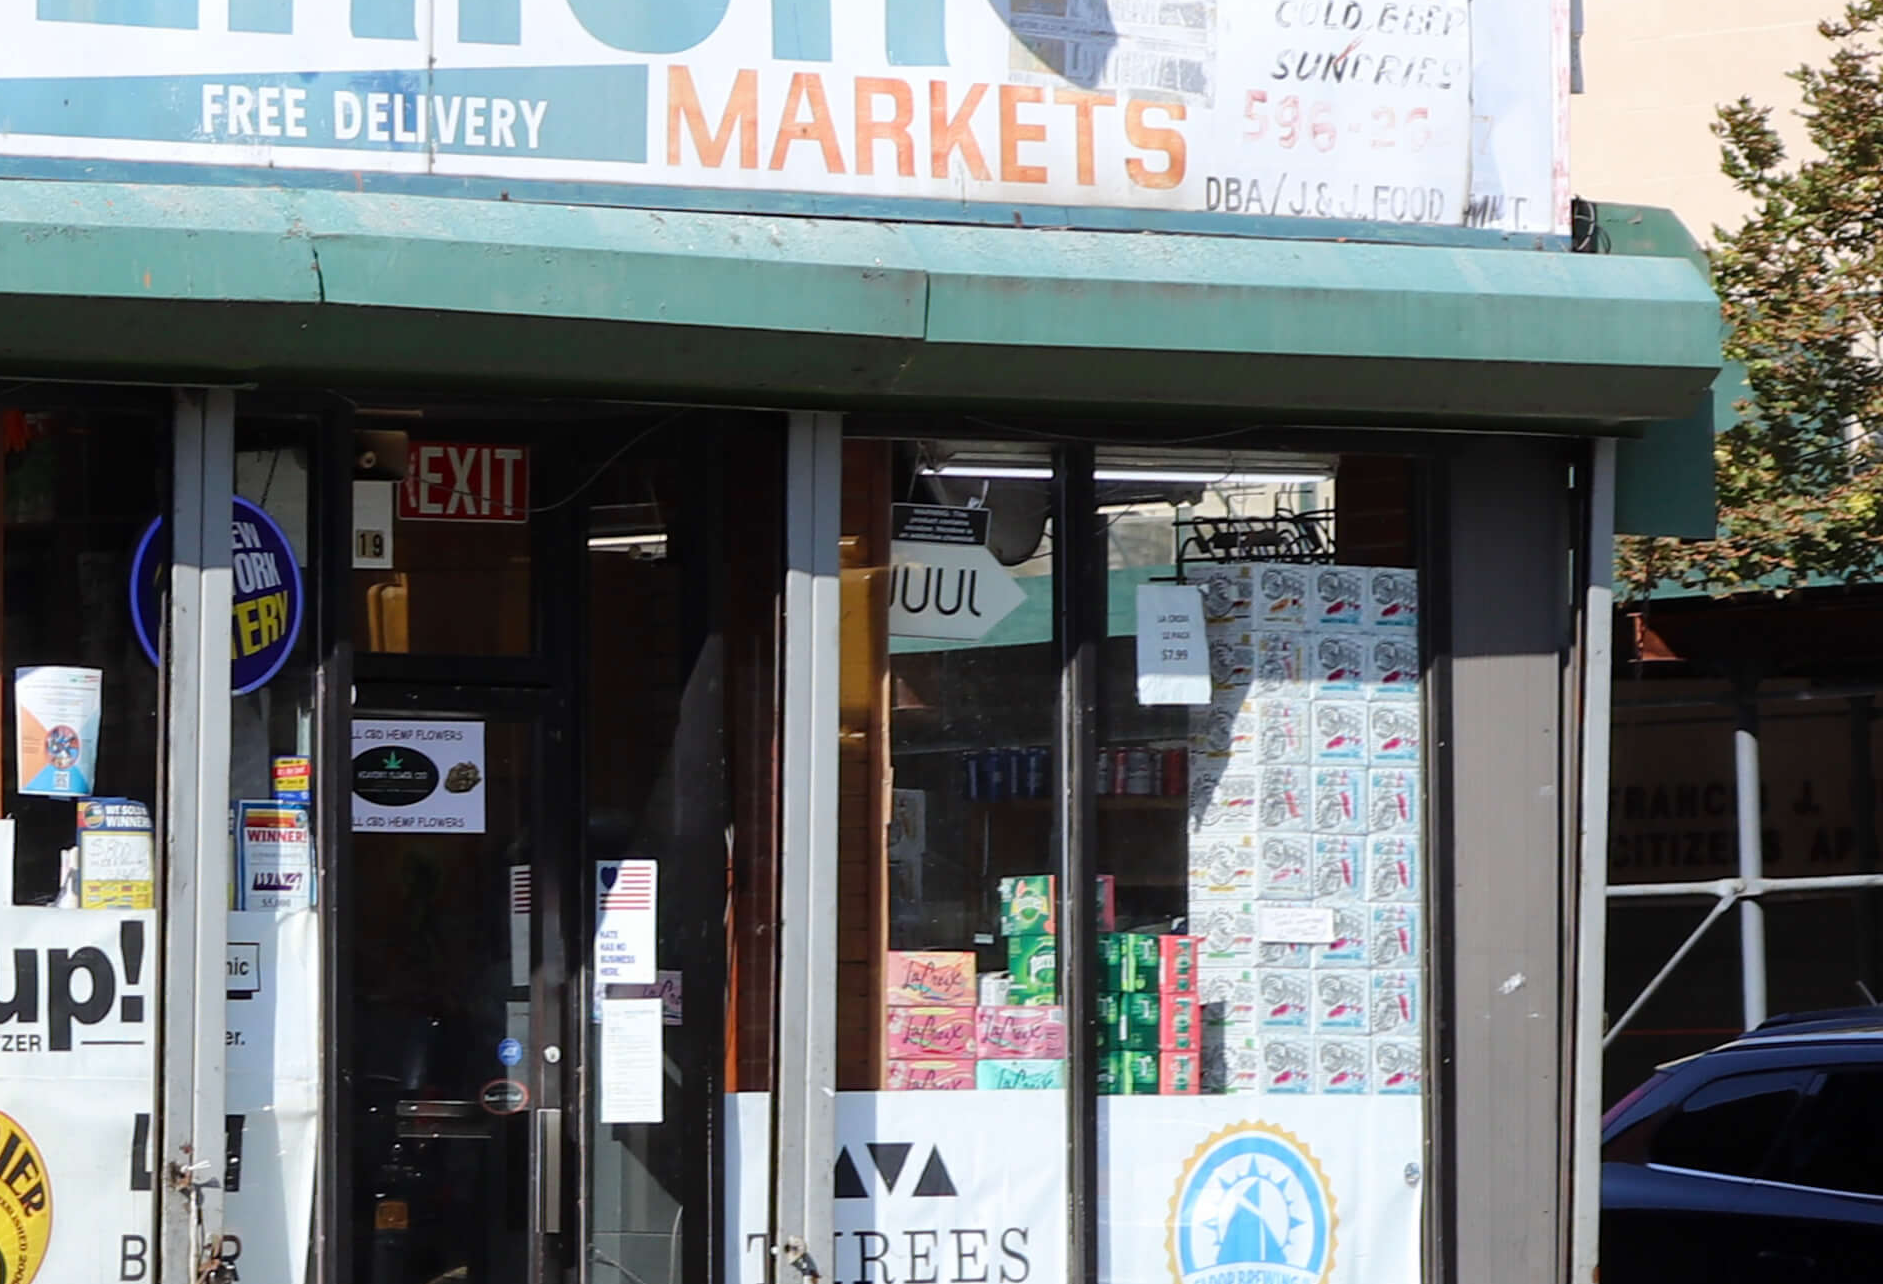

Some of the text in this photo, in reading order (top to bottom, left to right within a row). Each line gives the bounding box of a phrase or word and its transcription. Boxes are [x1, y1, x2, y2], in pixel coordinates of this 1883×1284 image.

[200, 83, 549, 151] FREE DELIVERY
[665, 64, 1188, 191] MARKETS
[418, 445, 524, 516] EXIT
[357, 531, 385, 558] 19
[416, 729, 464, 741] FLOWERS
[417, 816, 465, 828] FLOWERS
[246, 829, 308, 844] WINNER!
[599, 955, 636, 965] BUSINESS
